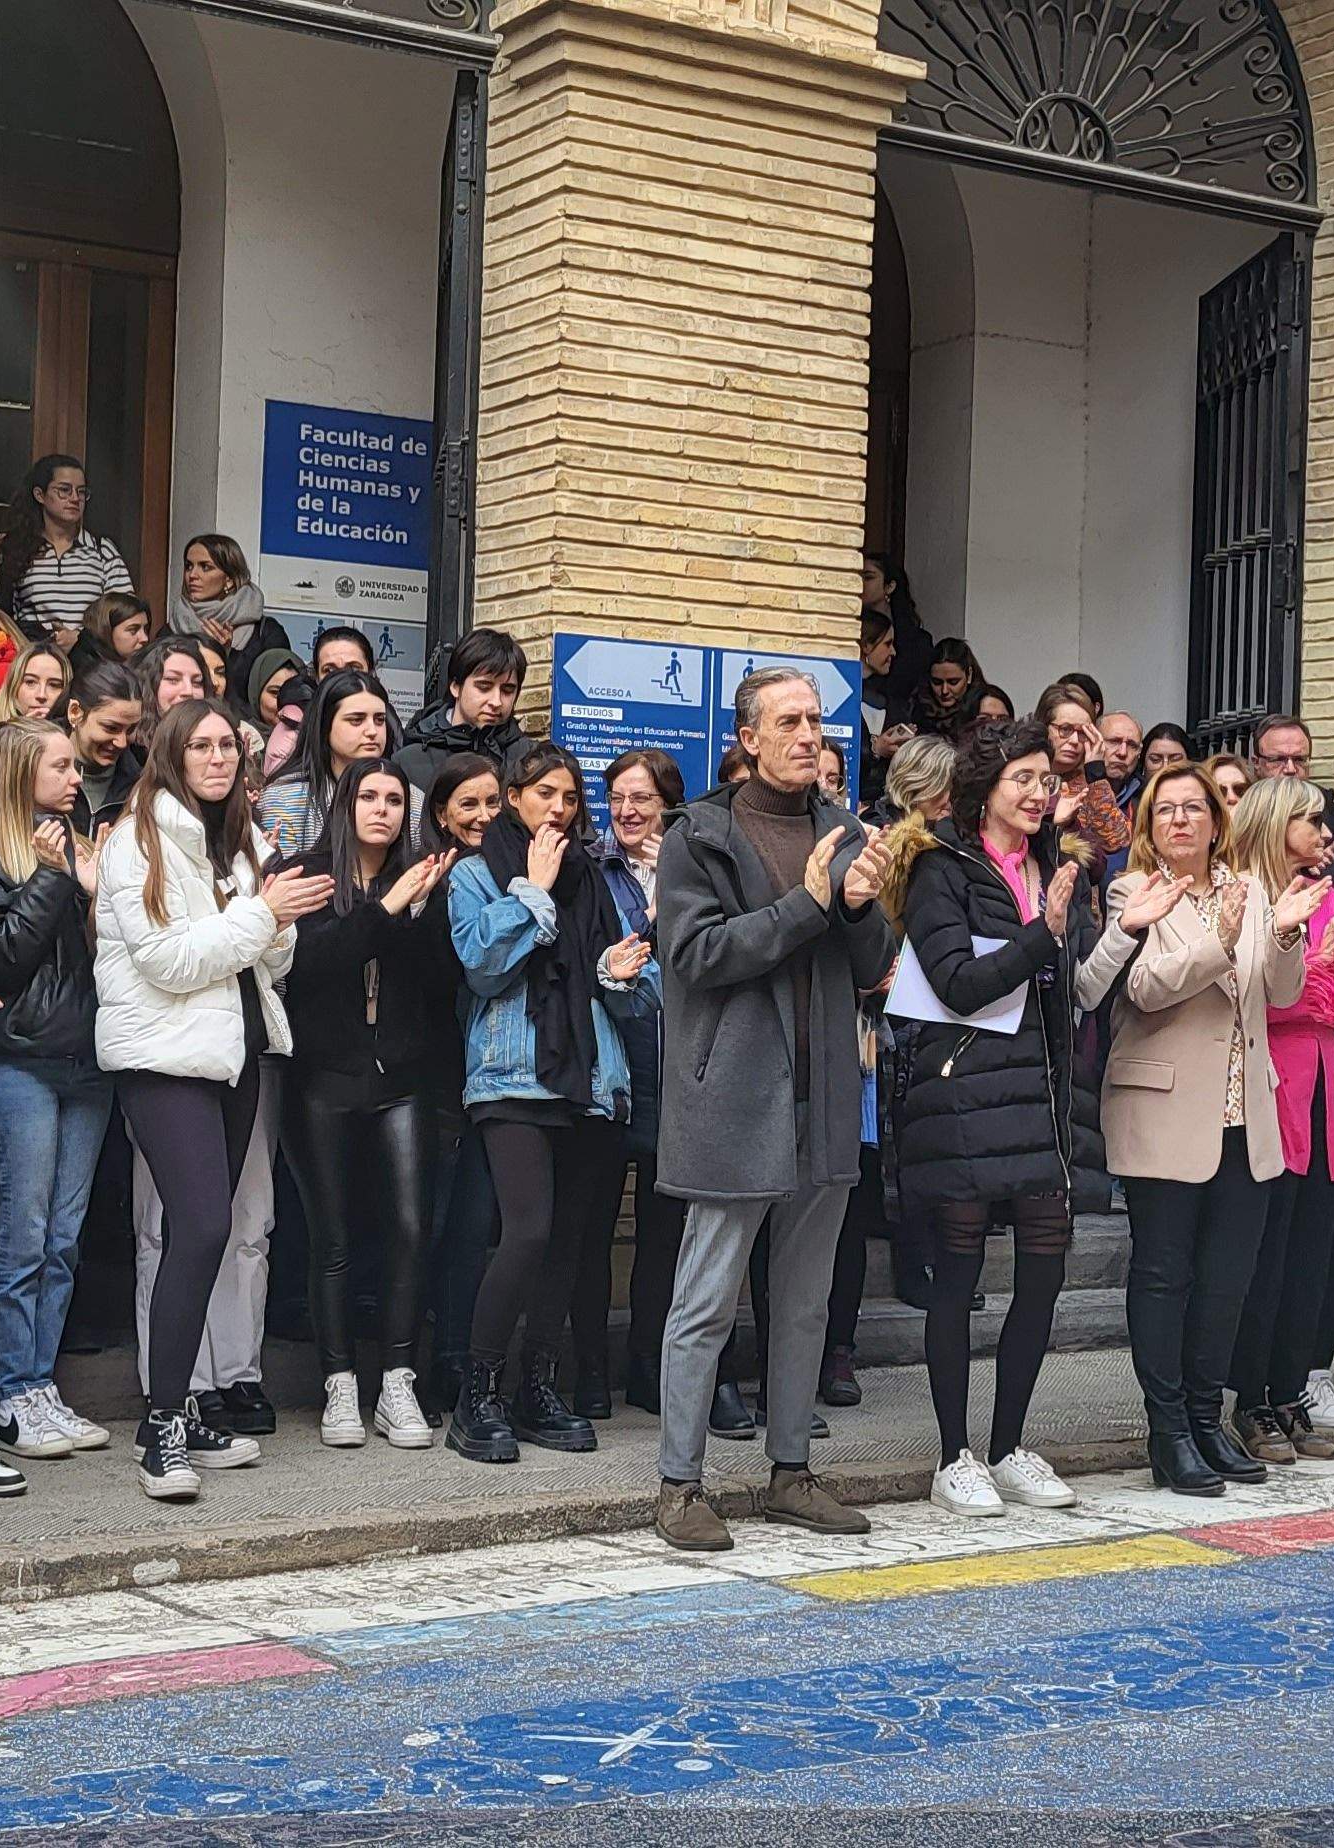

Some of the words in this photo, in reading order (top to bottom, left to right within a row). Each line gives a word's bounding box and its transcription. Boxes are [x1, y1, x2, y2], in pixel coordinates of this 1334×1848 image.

[299, 422, 394, 452] Facultad
[401, 433, 427, 456] de
[298, 447, 391, 474] Ciencias
[298, 470, 402, 498] Humanas
[408, 485, 421, 504] y
[297, 492, 324, 513] de
[332, 496, 351, 515] la
[296, 515, 409, 545] Educación
[359, 579, 420, 593] UNIVERSIDAD
[421, 585, 427, 594] D
[358, 590, 405, 602] ZARAGOZA
[587, 686, 624, 698] ACCESO
[625, 689, 632, 698] A
[570, 706, 614, 718] ESTUDIOS
[823, 706, 830, 714] A
[566, 721, 588, 731] Grado
[589, 722, 598, 731] de
[598, 723, 633, 734] Magisterio
[644, 726, 678, 737] Educación
[679, 729, 706, 739] Primaria
[821, 725, 845, 736] UDIOS
[565, 734, 590, 744] Máster
[590, 735, 632, 748] Universitario
[633, 739, 643, 747] en
[643, 739, 684, 750] Profesorado
[565, 743, 575, 751] de
[575, 743, 611, 754] Educación
[578, 760, 601, 769] REAS
[602, 761, 609, 769] Y
